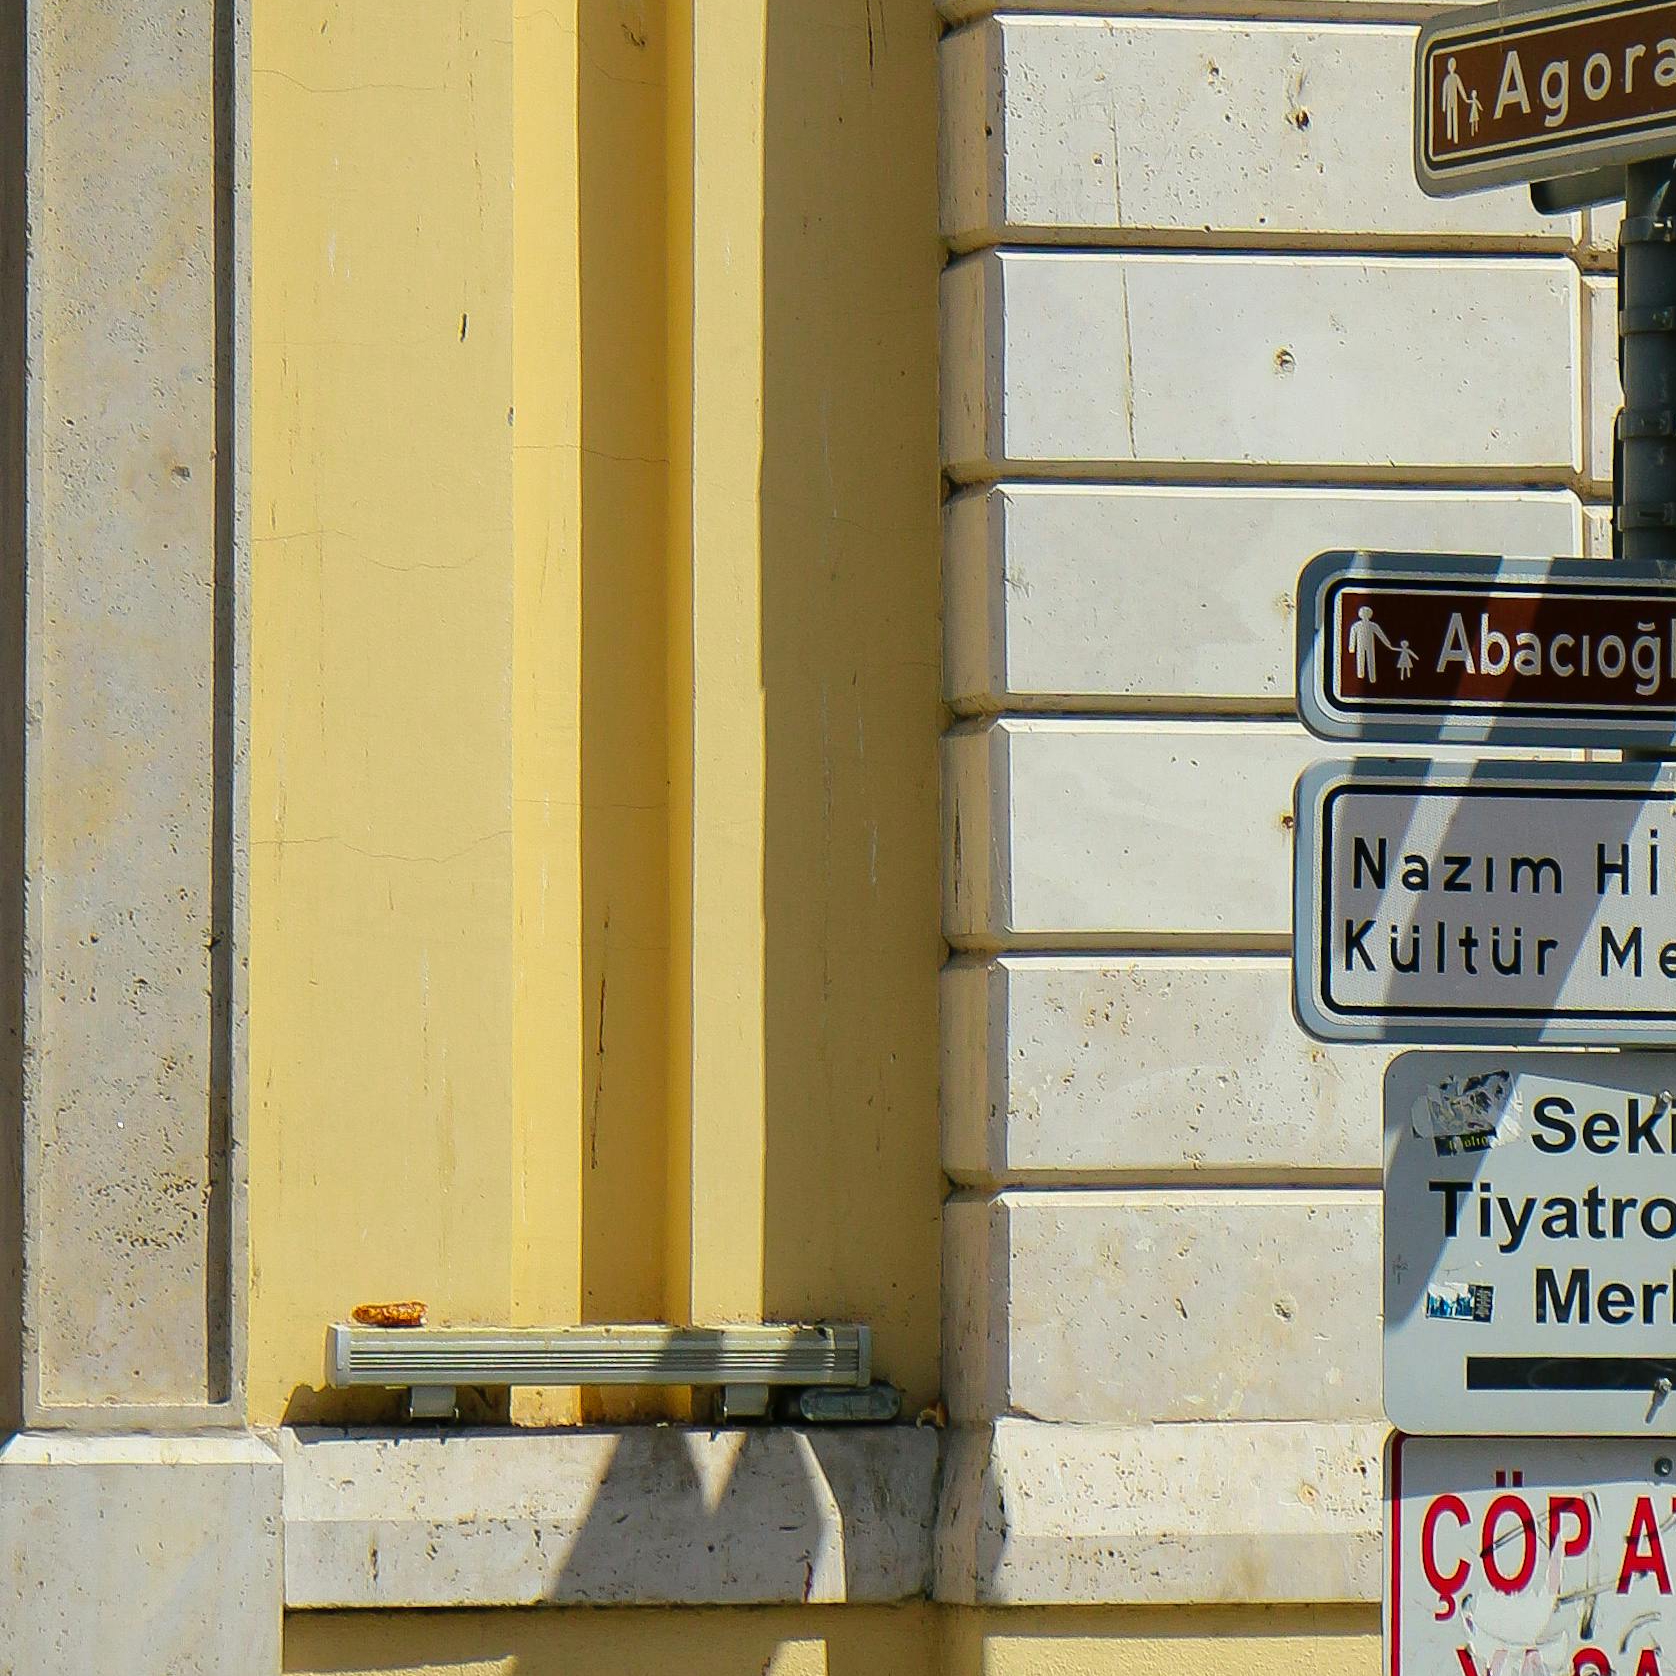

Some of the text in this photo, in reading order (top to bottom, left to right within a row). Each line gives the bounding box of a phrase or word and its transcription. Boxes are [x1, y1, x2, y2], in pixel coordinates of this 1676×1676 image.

[1352, 836, 1562, 895] Nazım
[1344, 918, 1558, 977] Kültür
[1421, 1470, 1592, 1622] ÇÖP
